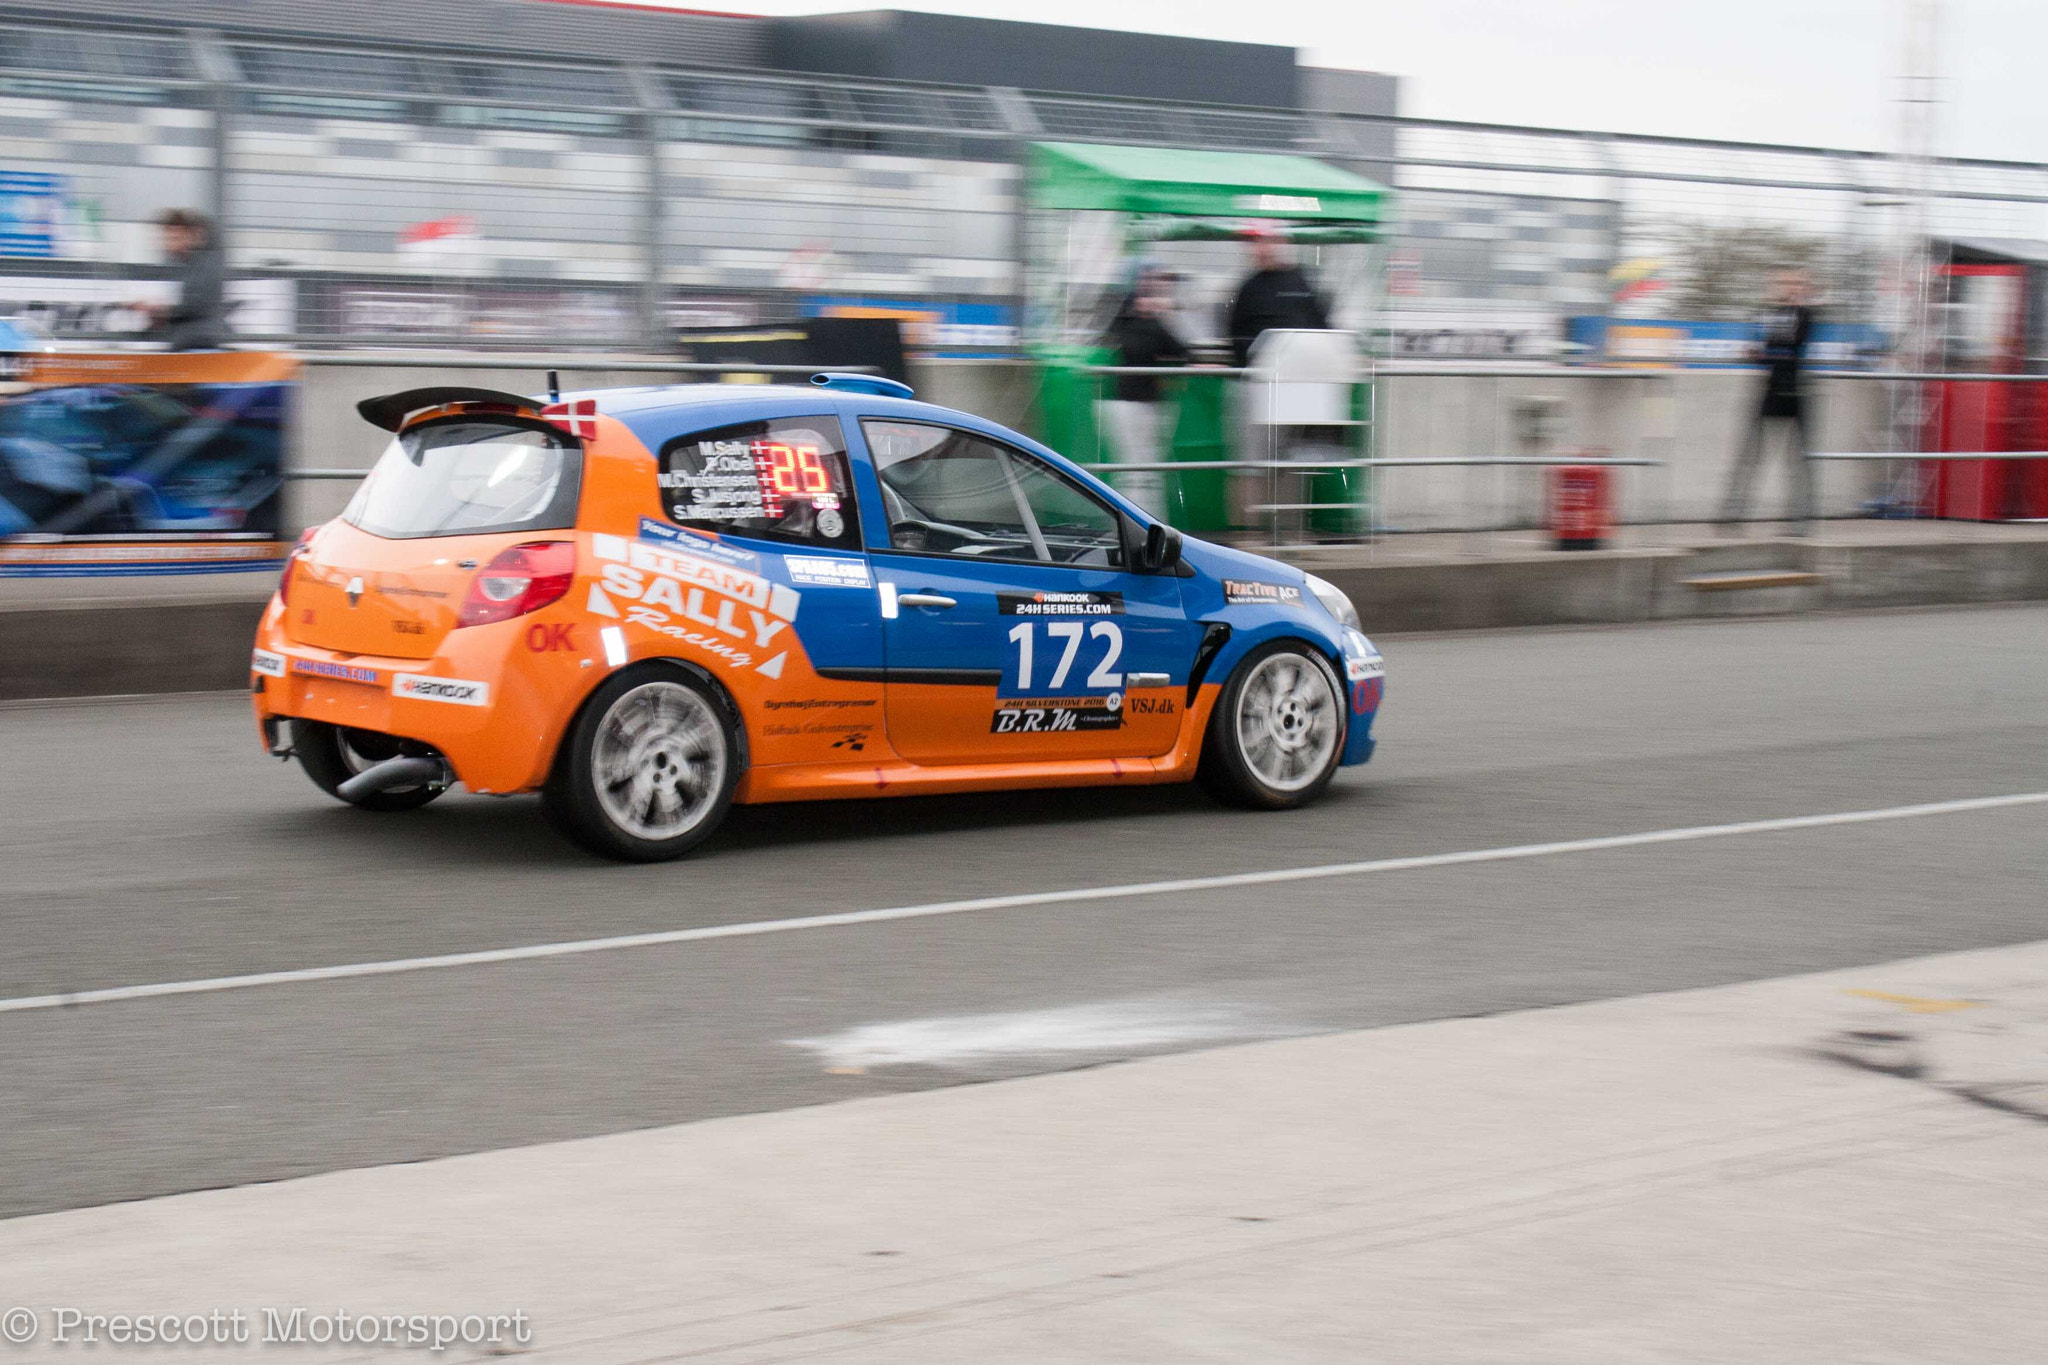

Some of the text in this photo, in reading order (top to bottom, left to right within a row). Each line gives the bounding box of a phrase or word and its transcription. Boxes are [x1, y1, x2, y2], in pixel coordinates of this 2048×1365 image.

[768, 444, 828, 493] 25
[647, 552, 758, 602] TEAM
[1279, 586, 1300, 600] ACE
[601, 563, 789, 649] SALLY
[525, 623, 577, 653] OK
[624, 605, 753, 668] Racing
[1008, 620, 1124, 690] 172
[1131, 698, 1175, 714] VSJ.dk
